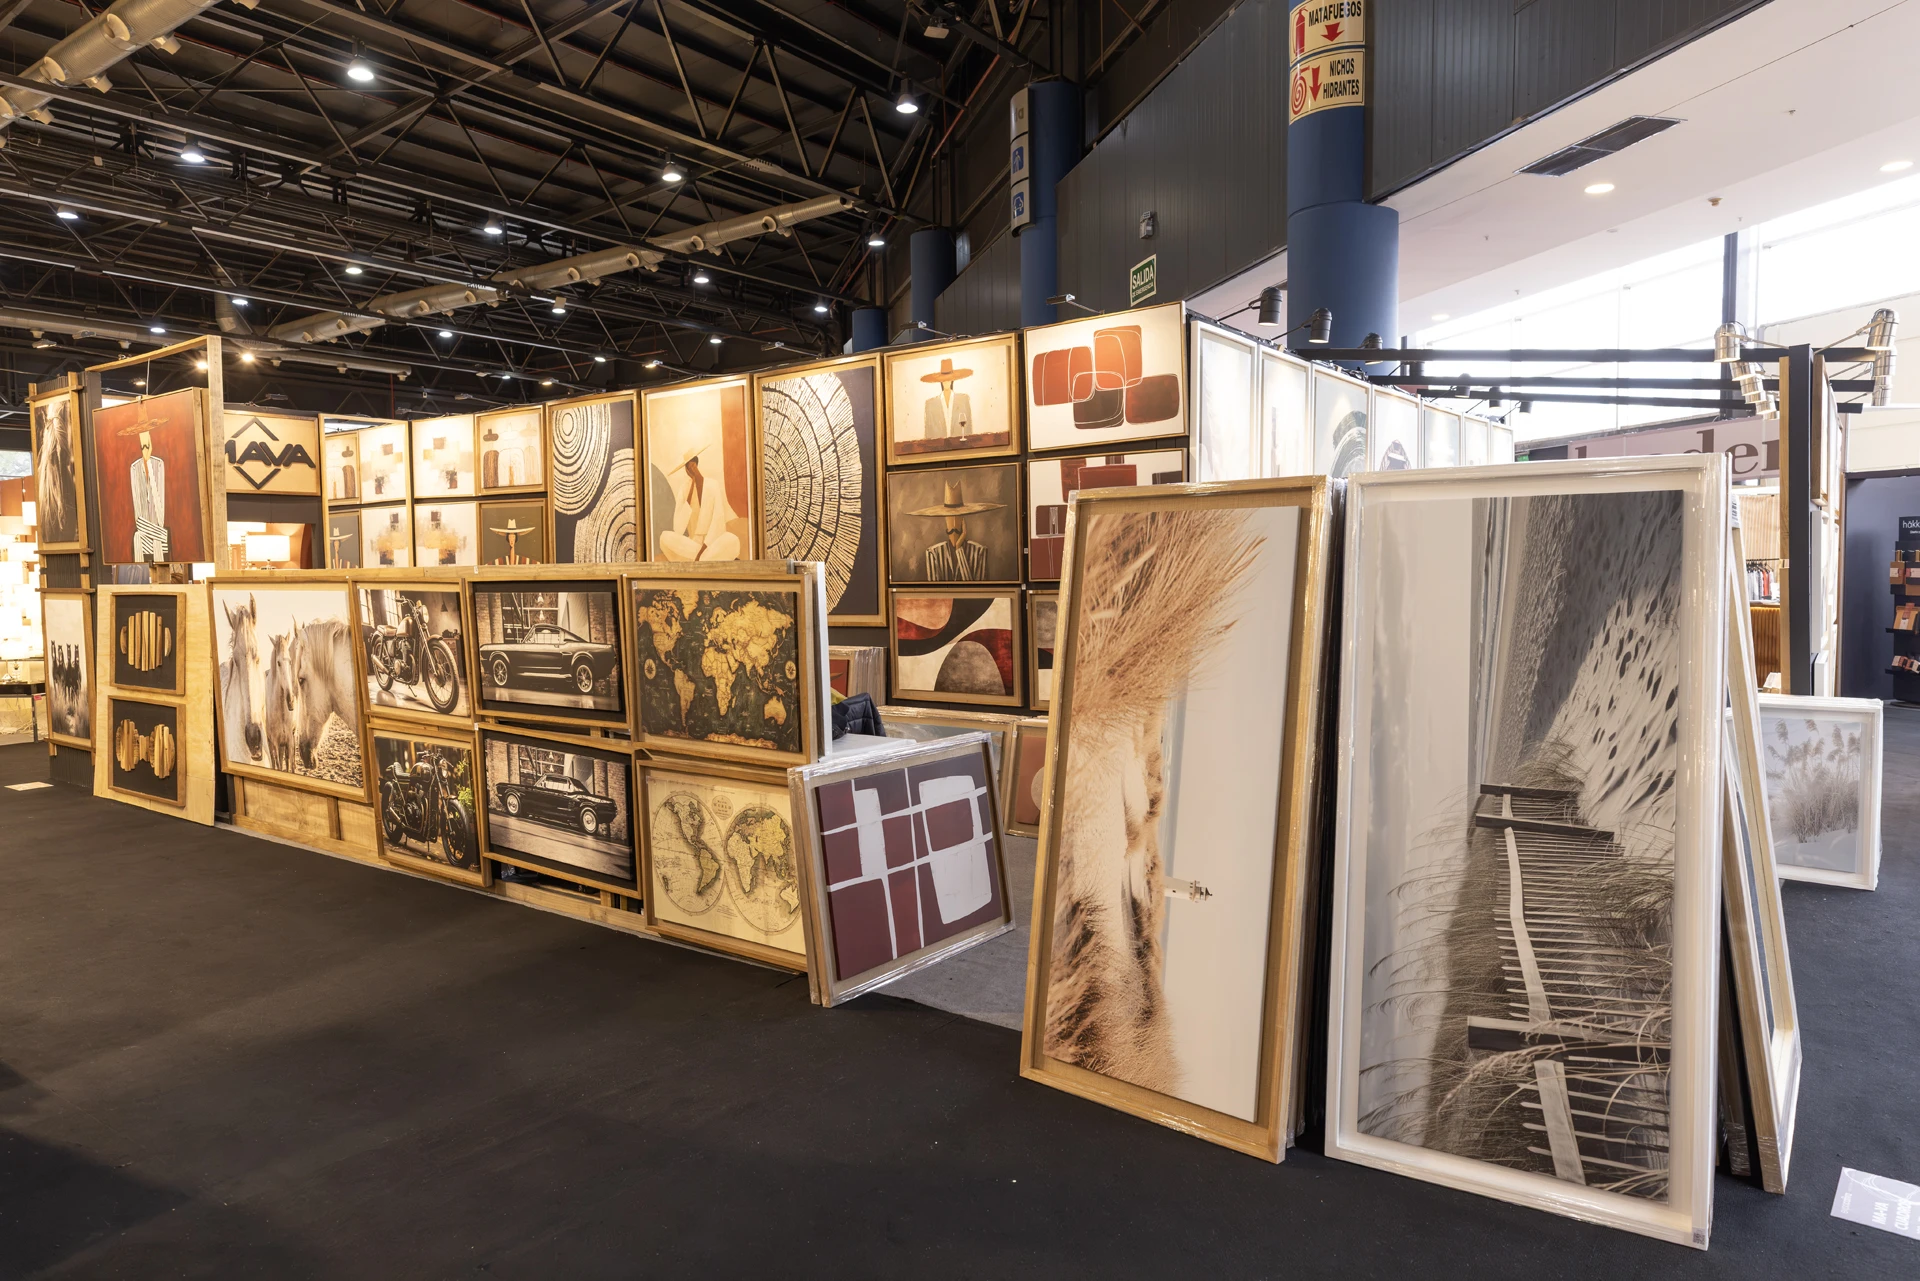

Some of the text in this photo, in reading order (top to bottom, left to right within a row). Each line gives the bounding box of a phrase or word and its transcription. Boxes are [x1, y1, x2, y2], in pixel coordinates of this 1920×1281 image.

[1308, 1, 1362, 27] MATAFUEGOS
[1329, 58, 1355, 77] NICHOS
[1323, 79, 1360, 100] HIDRANTES
[1132, 264, 1154, 290] SALIDA
